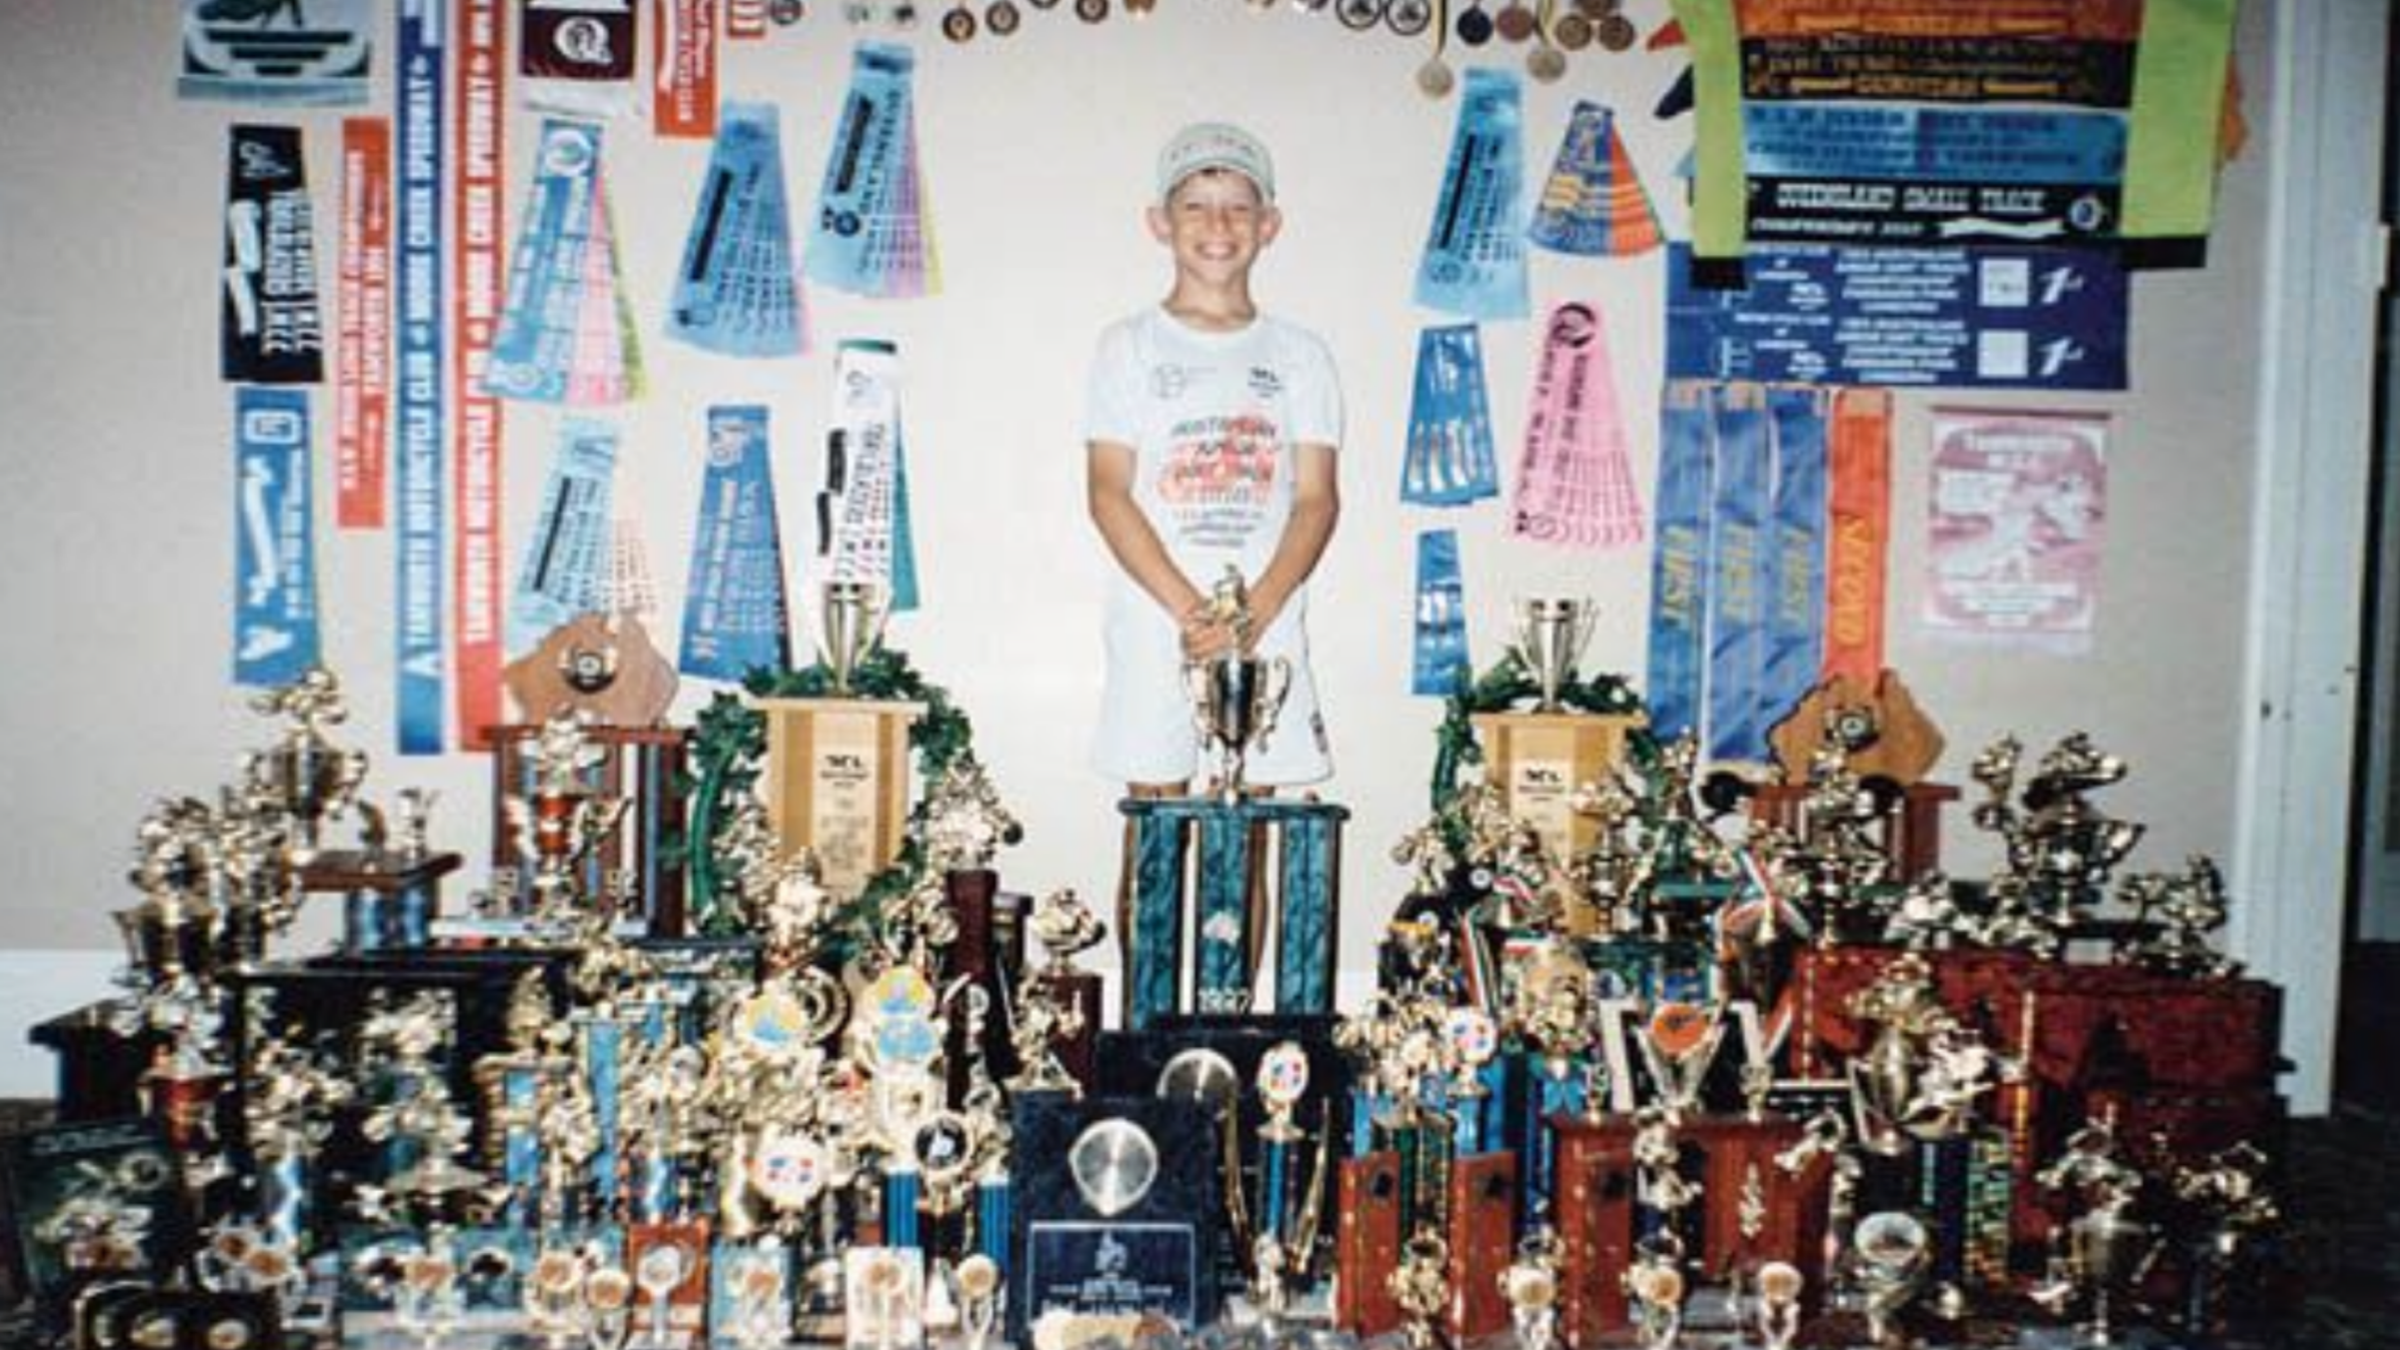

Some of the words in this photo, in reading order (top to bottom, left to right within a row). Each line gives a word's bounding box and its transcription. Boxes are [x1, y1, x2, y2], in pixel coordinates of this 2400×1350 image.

[407, 77, 432, 180] SPEEDWAY
[465, 77, 492, 179] SPEEDWAY
[407, 186, 432, 246] CREEK
[465, 185, 492, 245] CREEK
[1979, 188, 2046, 214] TRACK
[407, 351, 431, 399] CLUB
[1663, 523, 1697, 625] FIRST
[1833, 513, 1876, 648] SECOND
